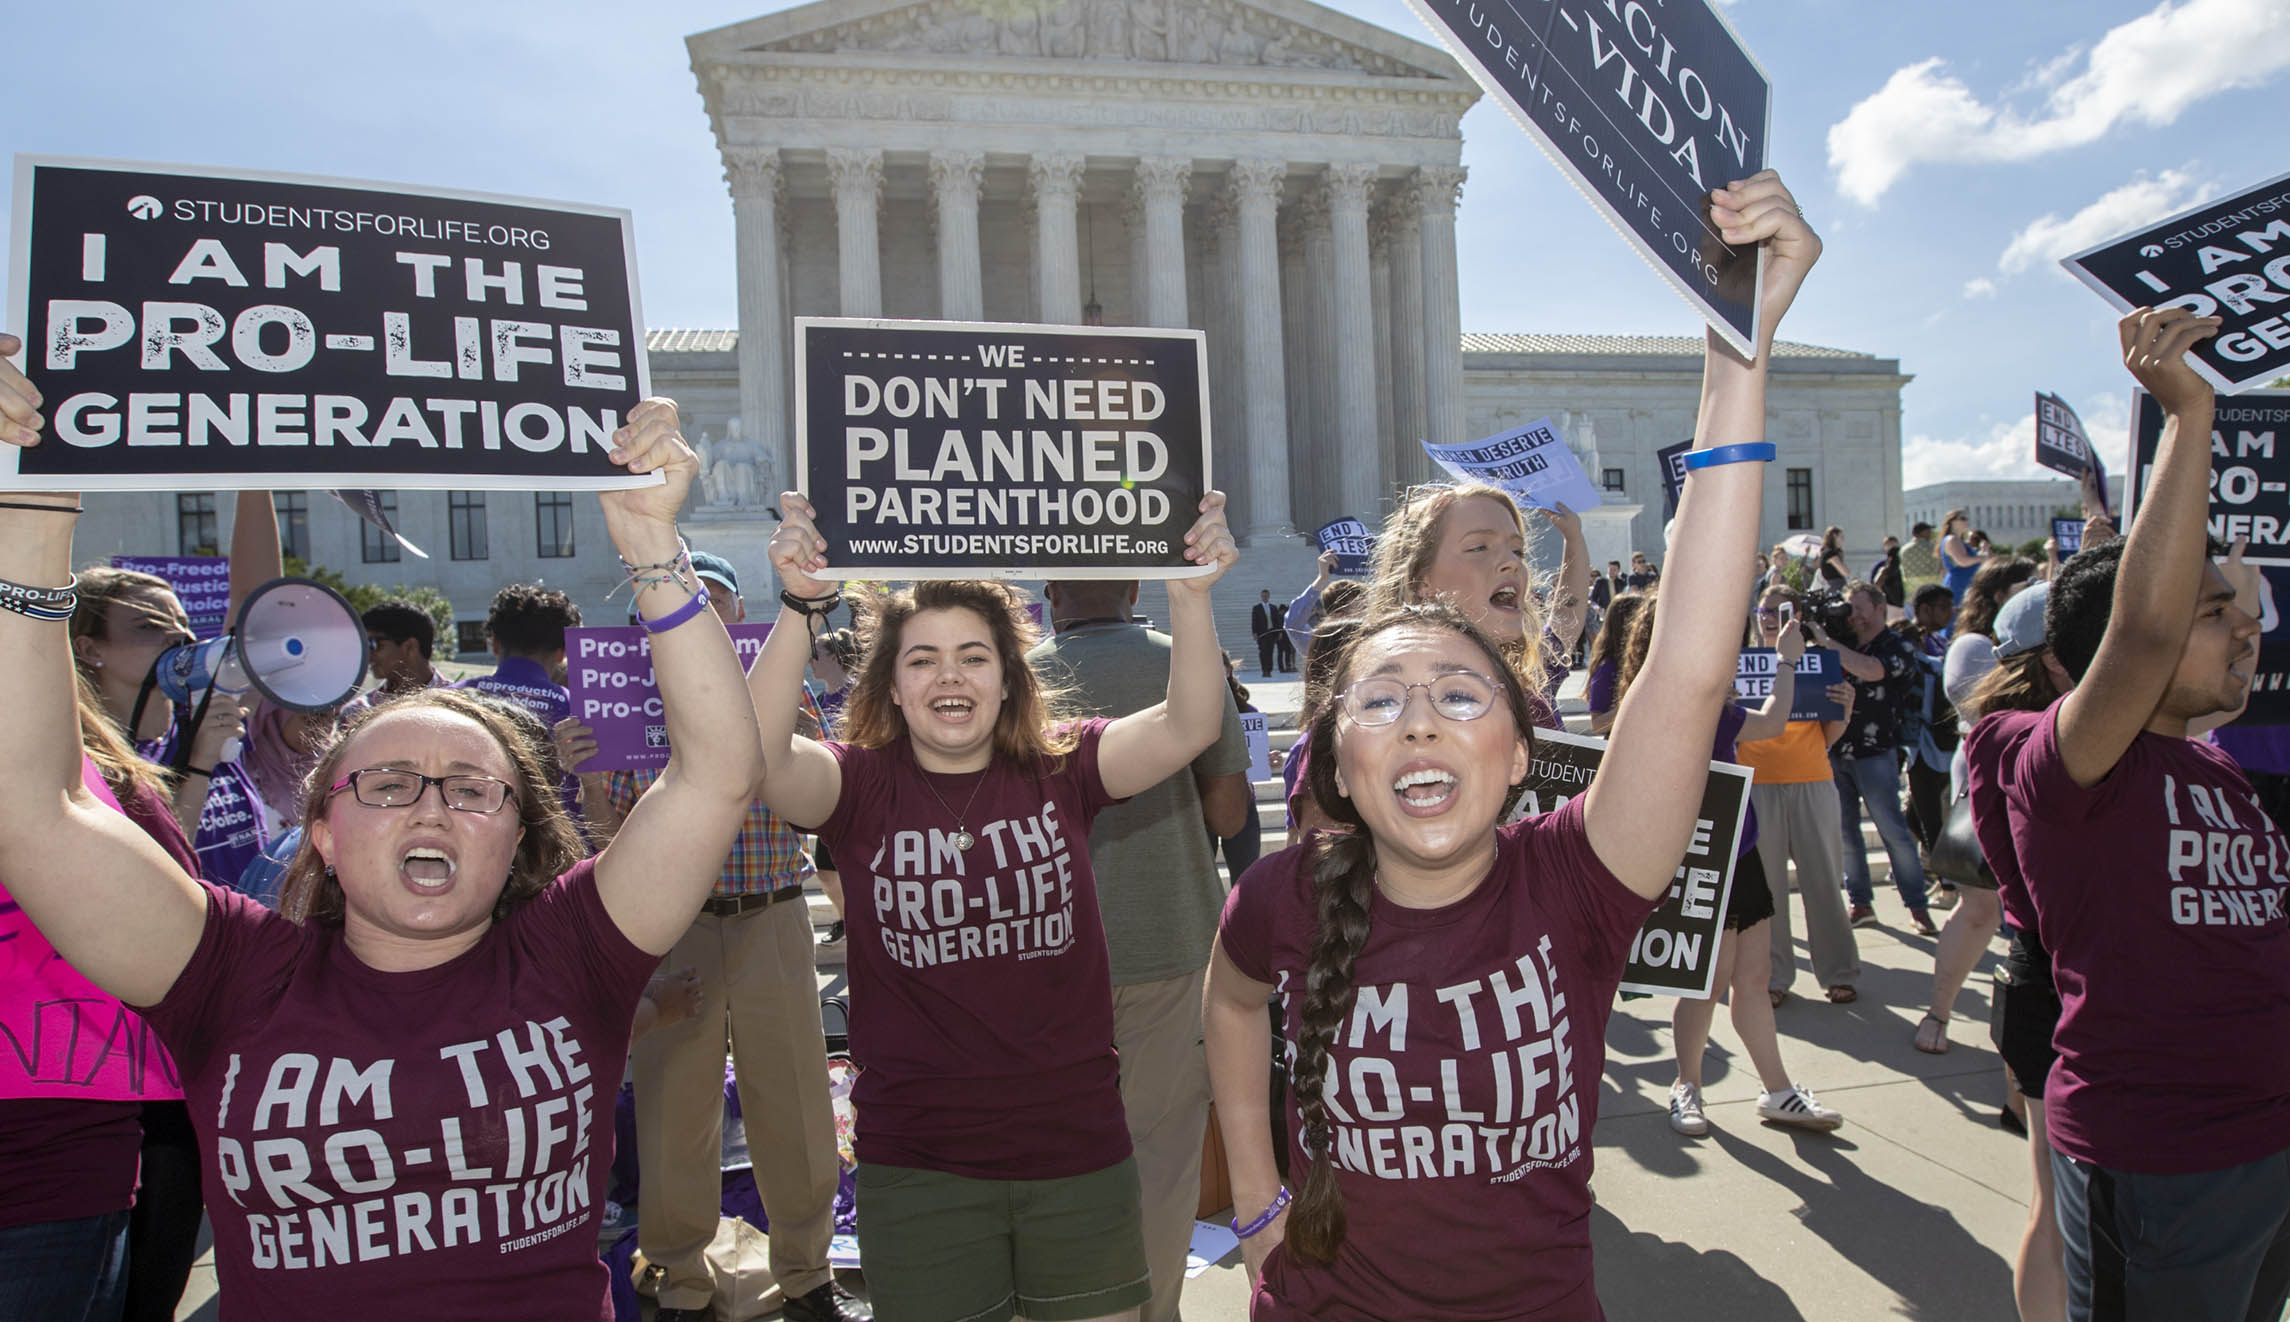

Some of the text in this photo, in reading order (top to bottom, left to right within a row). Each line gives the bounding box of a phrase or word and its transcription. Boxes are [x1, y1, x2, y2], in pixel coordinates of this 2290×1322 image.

[1456, 0, 1719, 286] UDENTSFORLIFE.ORG
[174, 200, 550, 250] STUDENTSFORLIFE.ORG
[82, 233, 588, 311] I AM THE
[2135, 270, 2171, 293] I
[46, 299, 627, 391] PRO-LIFE
[978, 345, 1025, 368] WE
[2215, 311, 2290, 362] GE
[54, 392, 618, 454] GENERATION
[844, 374, 1166, 421] DON'T NEED
[846, 426, 1169, 482] PLANNED
[1481, 428, 1552, 462] DESERVE
[846, 487, 1170, 525] PARENTHOOD
[1321, 523, 1352, 541] END
[2164, 774, 2181, 825] I
[869, 800, 1066, 876] I AM THE
[873, 852, 1073, 931] PRO-LIFE
[881, 902, 1074, 969] GENERATION
[218, 1016, 592, 1131] I AM THE
[218, 1083, 594, 1209] PRO-LIFE
[246, 1154, 591, 1271] GENERATION
[500, 1211, 590, 1255] STUDENTSFORLIFE.ORG
